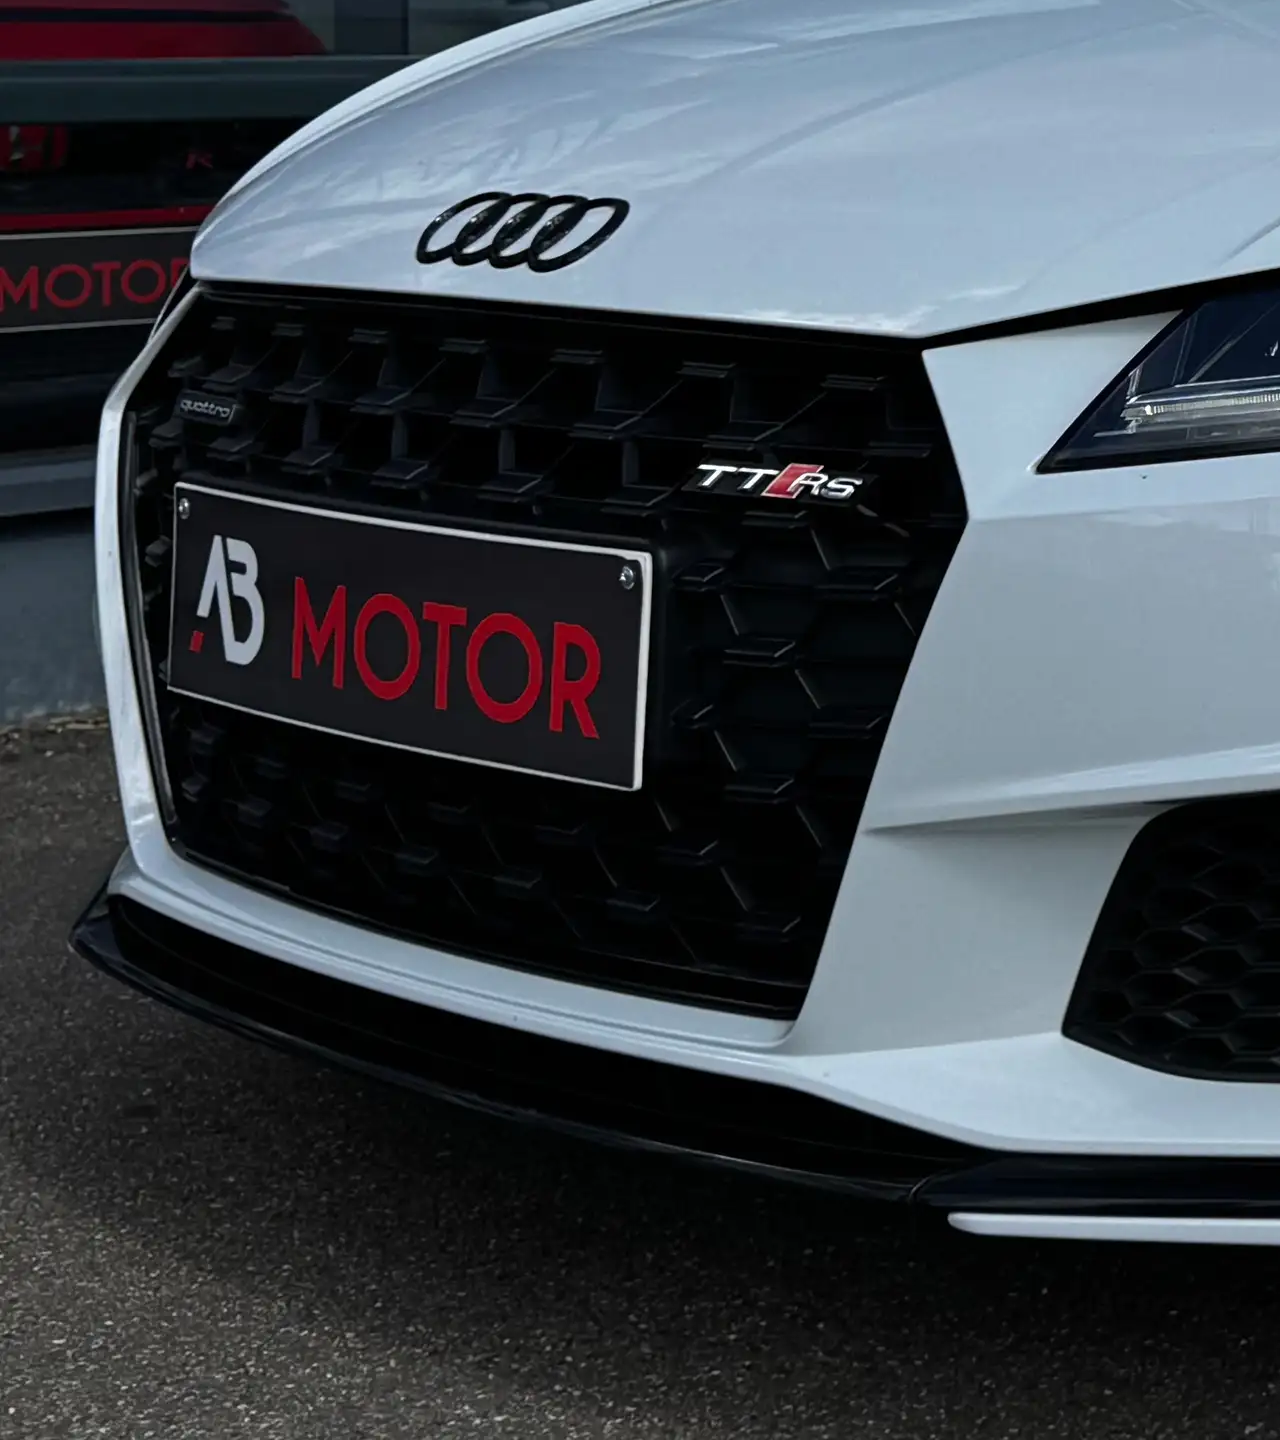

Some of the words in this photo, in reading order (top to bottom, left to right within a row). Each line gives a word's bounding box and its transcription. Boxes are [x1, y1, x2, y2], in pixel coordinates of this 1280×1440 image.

[181, 399, 231, 418] quattro
[196, 535, 265, 666] AB
[291, 576, 601, 740] MOTOR
